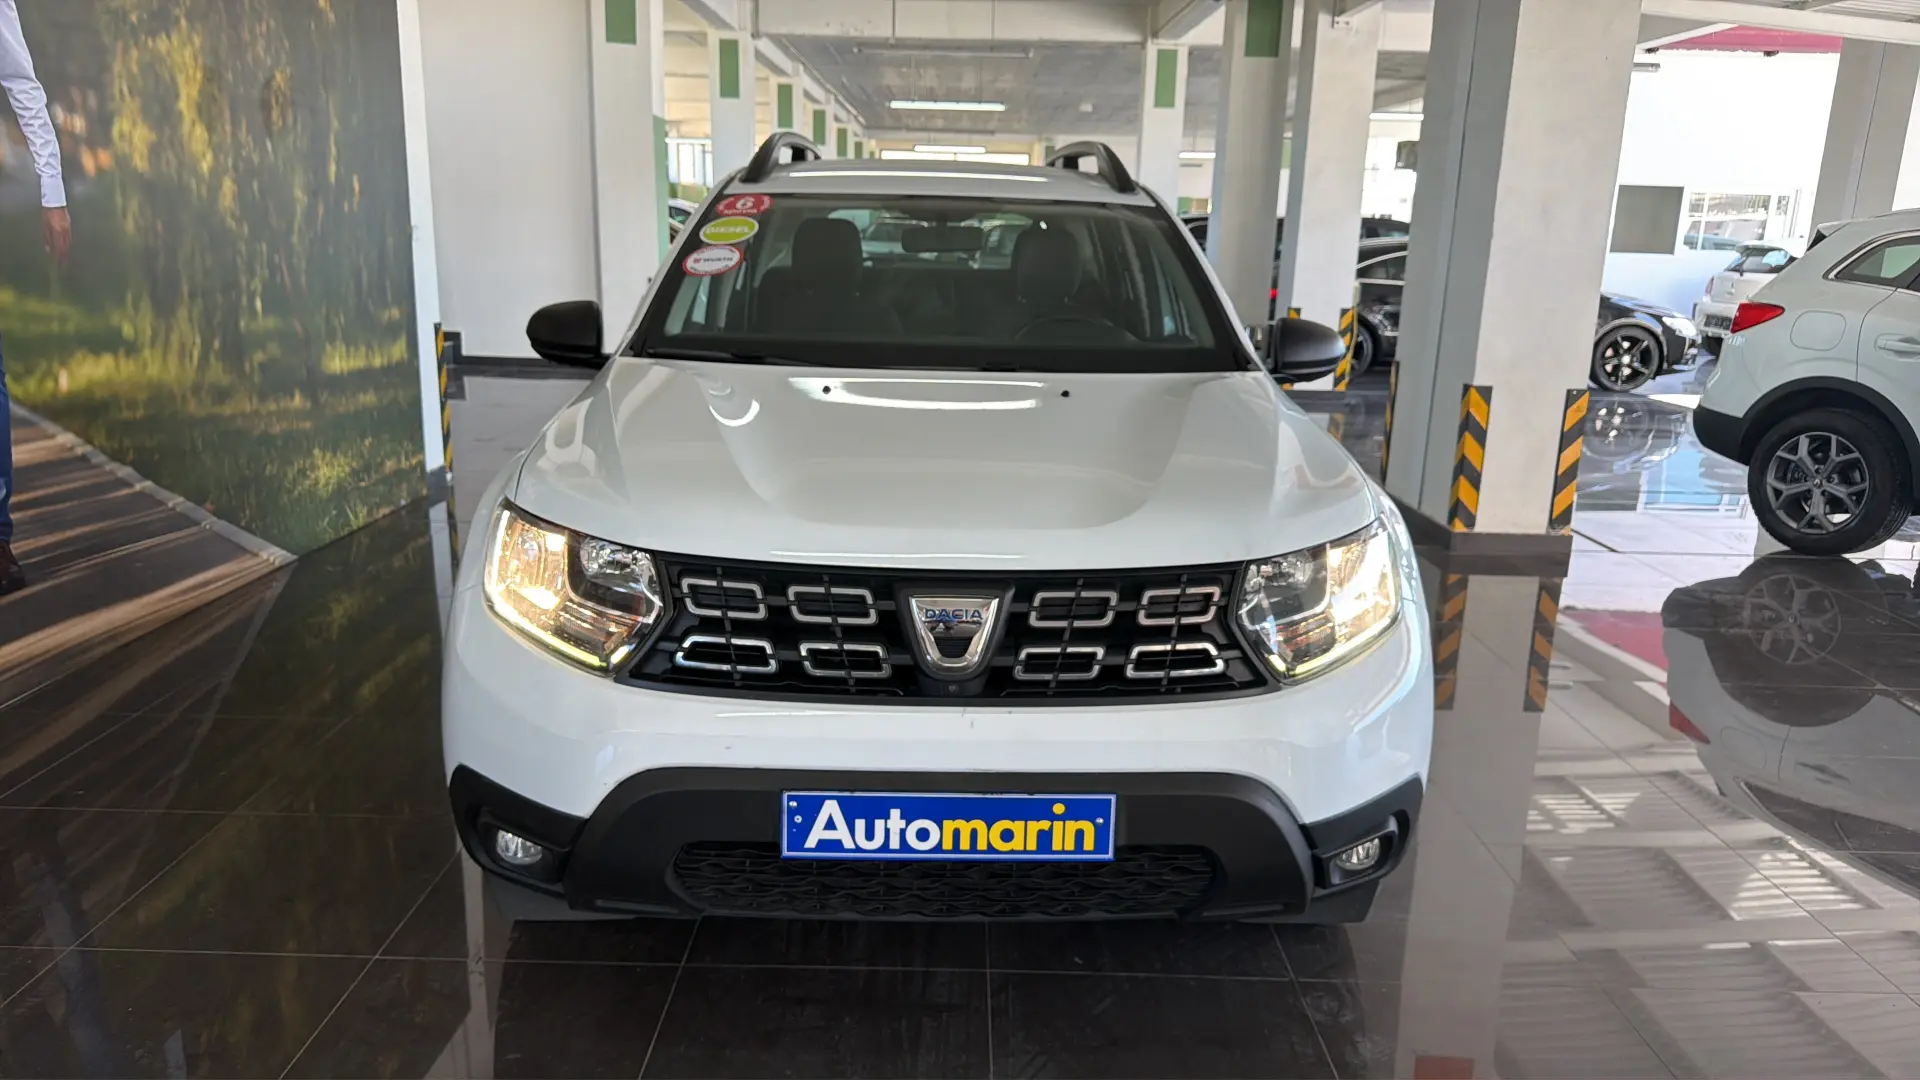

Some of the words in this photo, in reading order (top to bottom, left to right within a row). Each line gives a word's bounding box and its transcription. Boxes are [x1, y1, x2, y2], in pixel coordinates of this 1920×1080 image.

[736, 196, 755, 210] 6
[924, 608, 983, 620] DACIA
[804, 799, 1095, 851] Automarin
